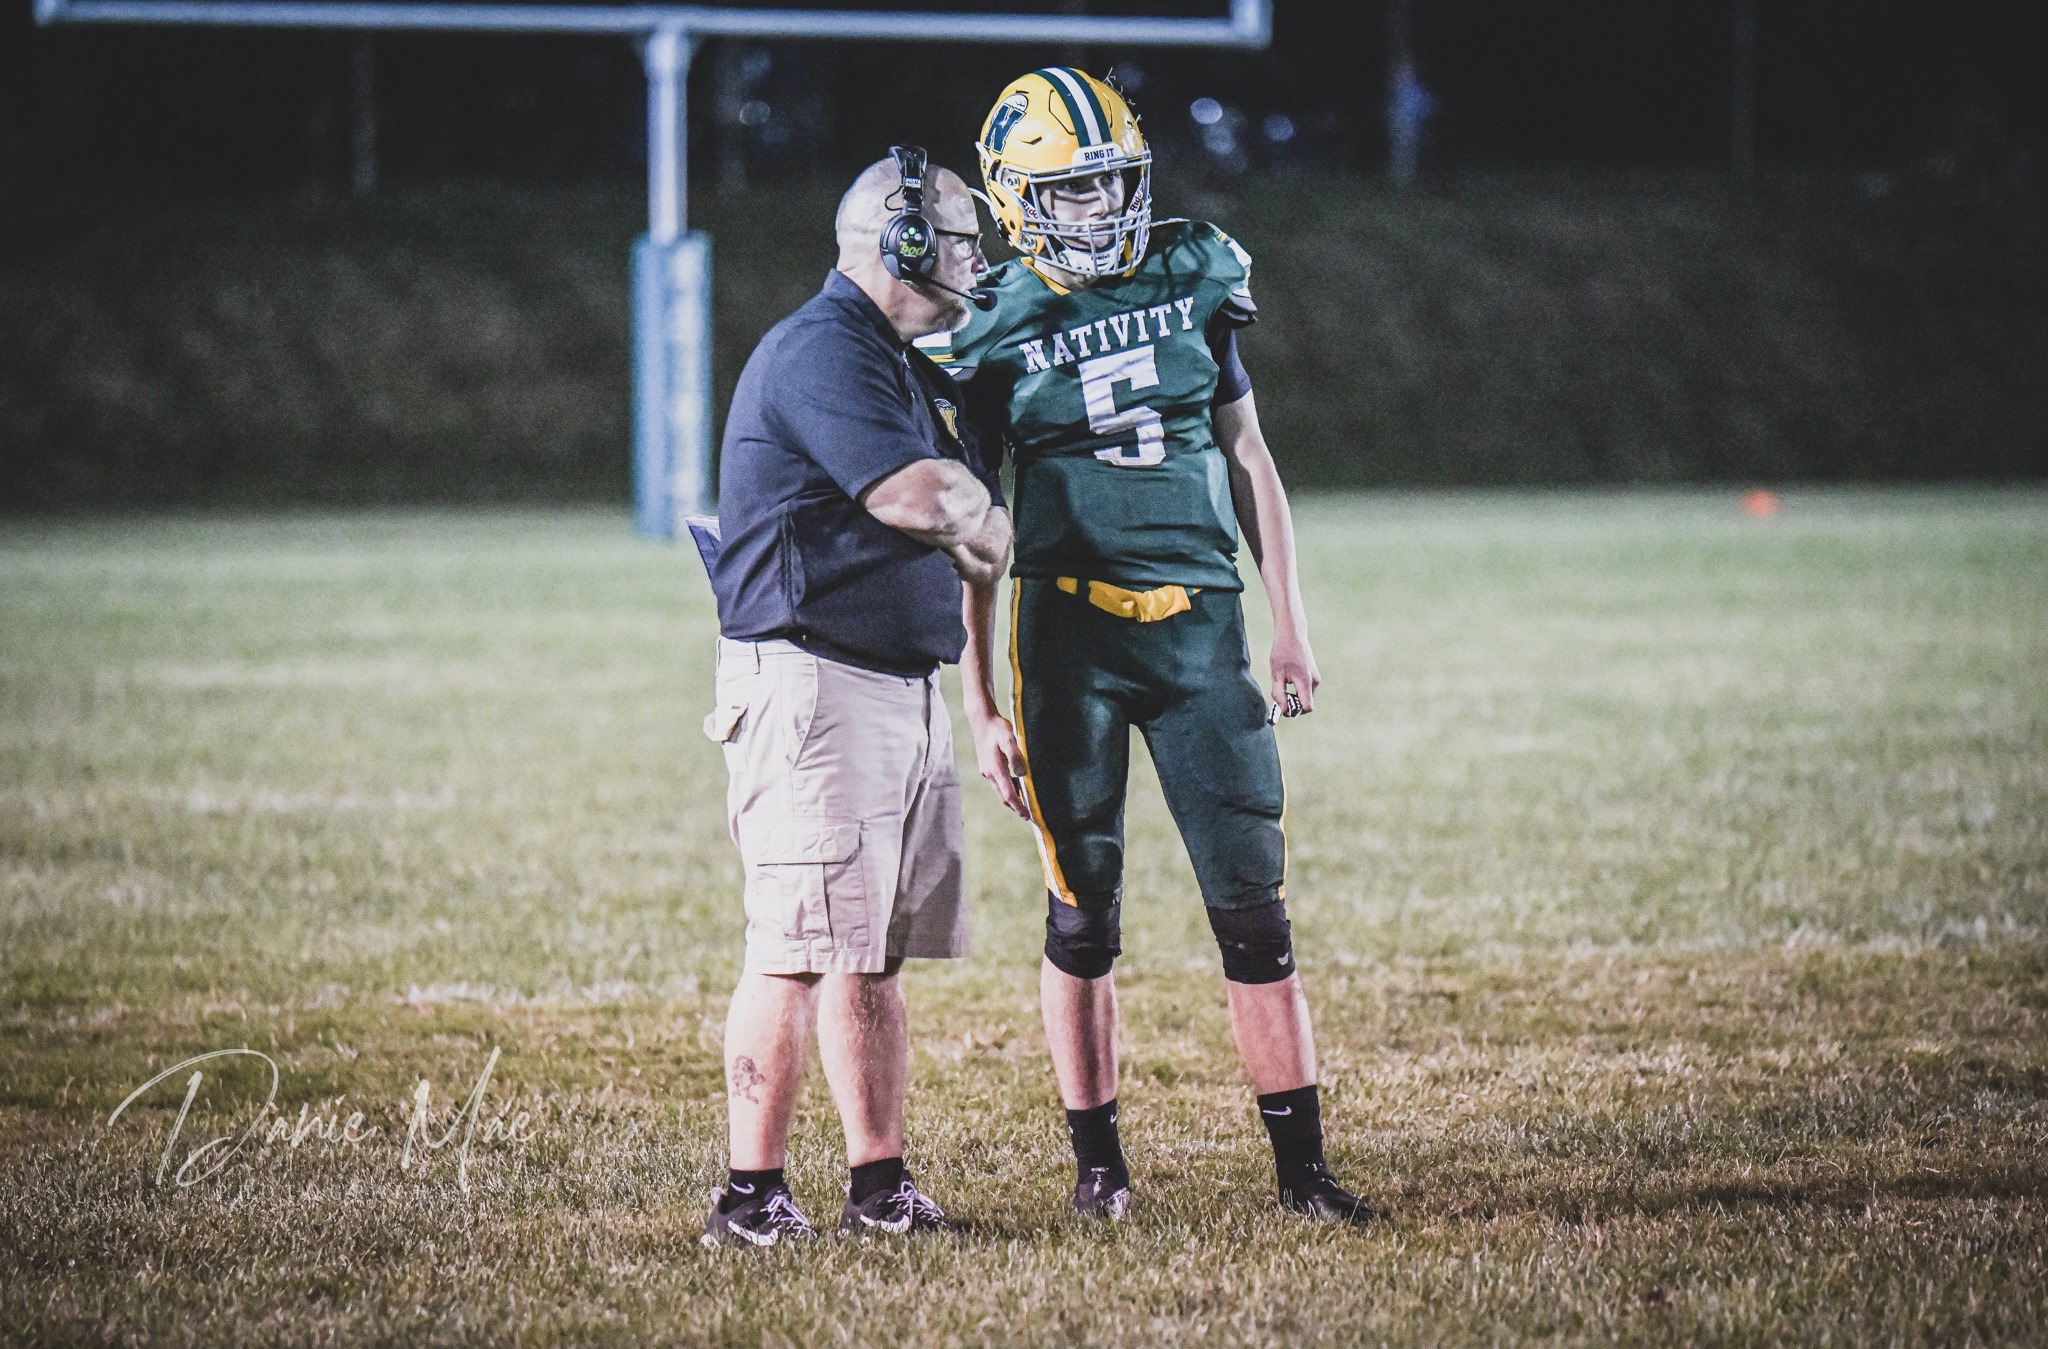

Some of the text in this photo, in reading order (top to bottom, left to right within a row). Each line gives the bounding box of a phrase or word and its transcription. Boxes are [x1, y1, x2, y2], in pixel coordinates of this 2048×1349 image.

[1084, 147, 1114, 161] RING IT
[1018, 296, 1195, 374] NATIVITY
[1077, 344, 1166, 466] 5
